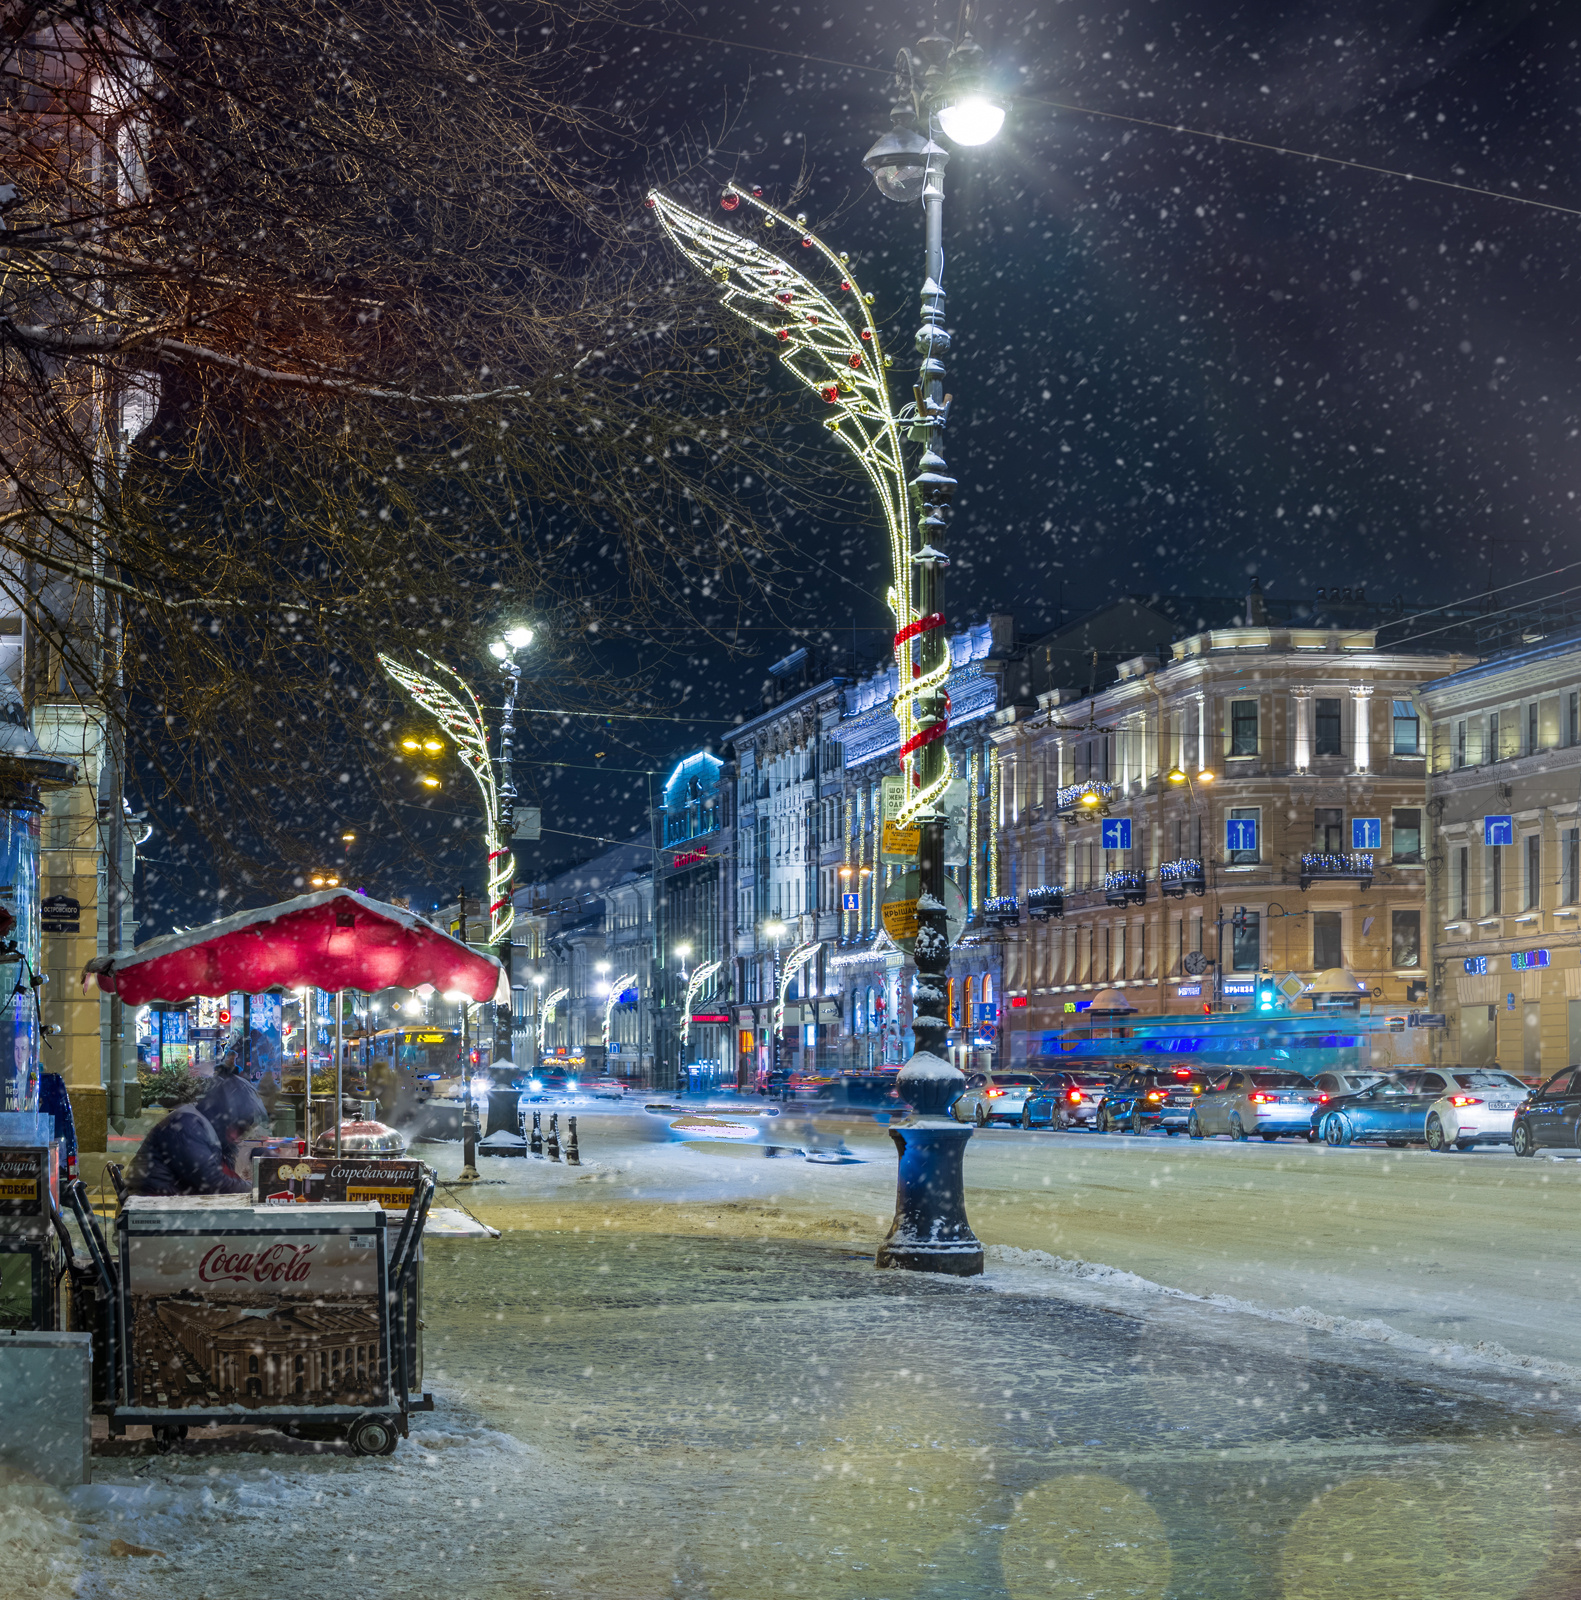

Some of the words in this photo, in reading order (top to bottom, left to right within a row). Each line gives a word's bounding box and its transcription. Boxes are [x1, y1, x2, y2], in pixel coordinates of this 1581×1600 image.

[43, 906, 78, 914] ОСТРОВСКОГО
[1224, 985, 1255, 994] БРЫНЗА
[331, 1164, 415, 1184] Согревающий
[349, 1191, 413, 1205] ГЛИНТВЕЙН
